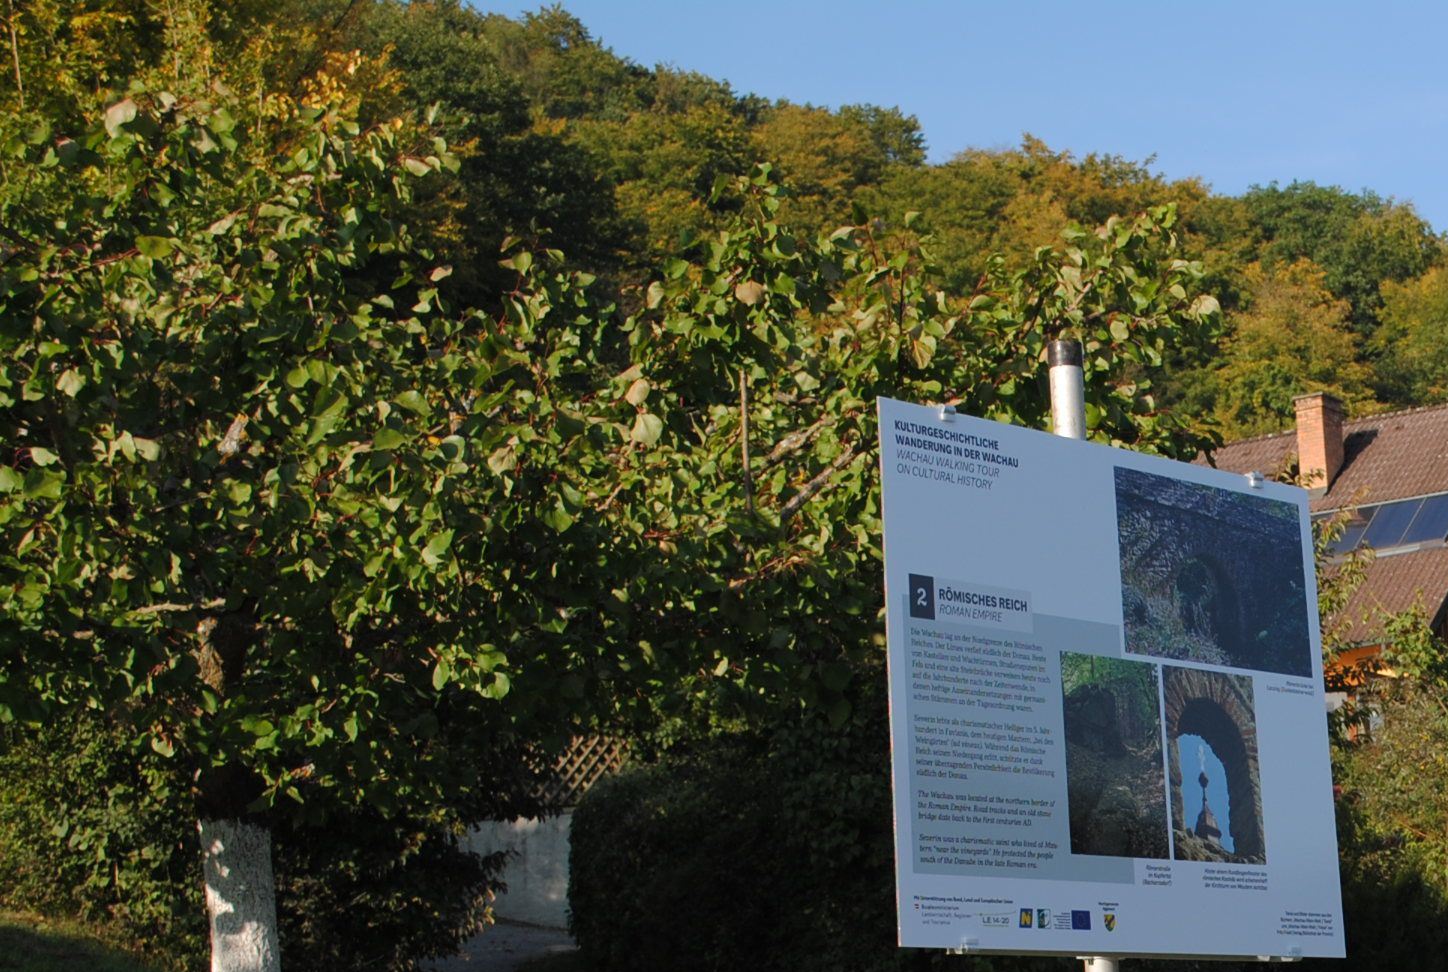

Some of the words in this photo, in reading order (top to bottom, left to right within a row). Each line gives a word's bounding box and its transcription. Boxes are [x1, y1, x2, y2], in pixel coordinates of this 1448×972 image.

[894, 420, 999, 450] KULTURGESCHICHTLICHE
[895, 434, 952, 454] WANDERUNG
[954, 446, 962, 456] IN
[964, 448, 980, 460] DER
[982, 452, 1018, 468] WACHAU
[897, 449, 934, 465] WACHAU
[936, 457, 974, 474] WALKING
[978, 465, 999, 478] TOUR
[897, 463, 910, 474] ON
[912, 466, 955, 484] CULTURAL
[957, 474, 992, 490] HISTORY
[916, 587, 927, 606] 2
[939, 586, 996, 607] RÖMISCHES
[999, 598, 1027, 612] REICH
[939, 604, 971, 618] ROMAN
[972, 608, 1002, 622] EMPIRE
